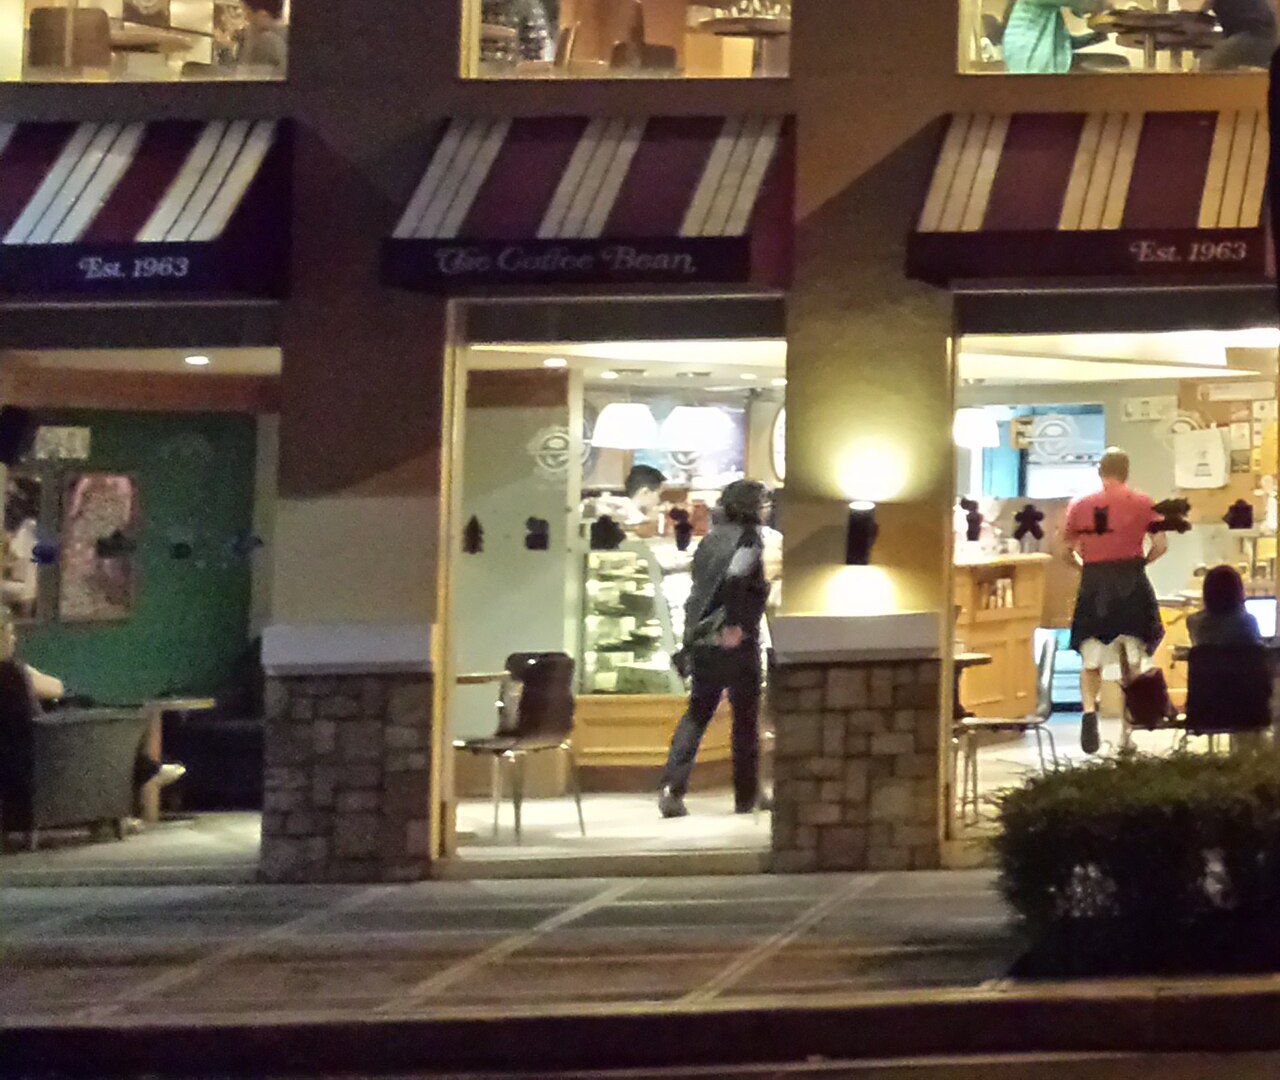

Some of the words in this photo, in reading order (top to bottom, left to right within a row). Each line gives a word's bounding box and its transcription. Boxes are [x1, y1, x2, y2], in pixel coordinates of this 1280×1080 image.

[434, 247, 491, 273] The
[497, 245, 597, 271] Coffee
[1188, 240, 1248, 261] 1963
[131, 256, 190, 278] 1963
